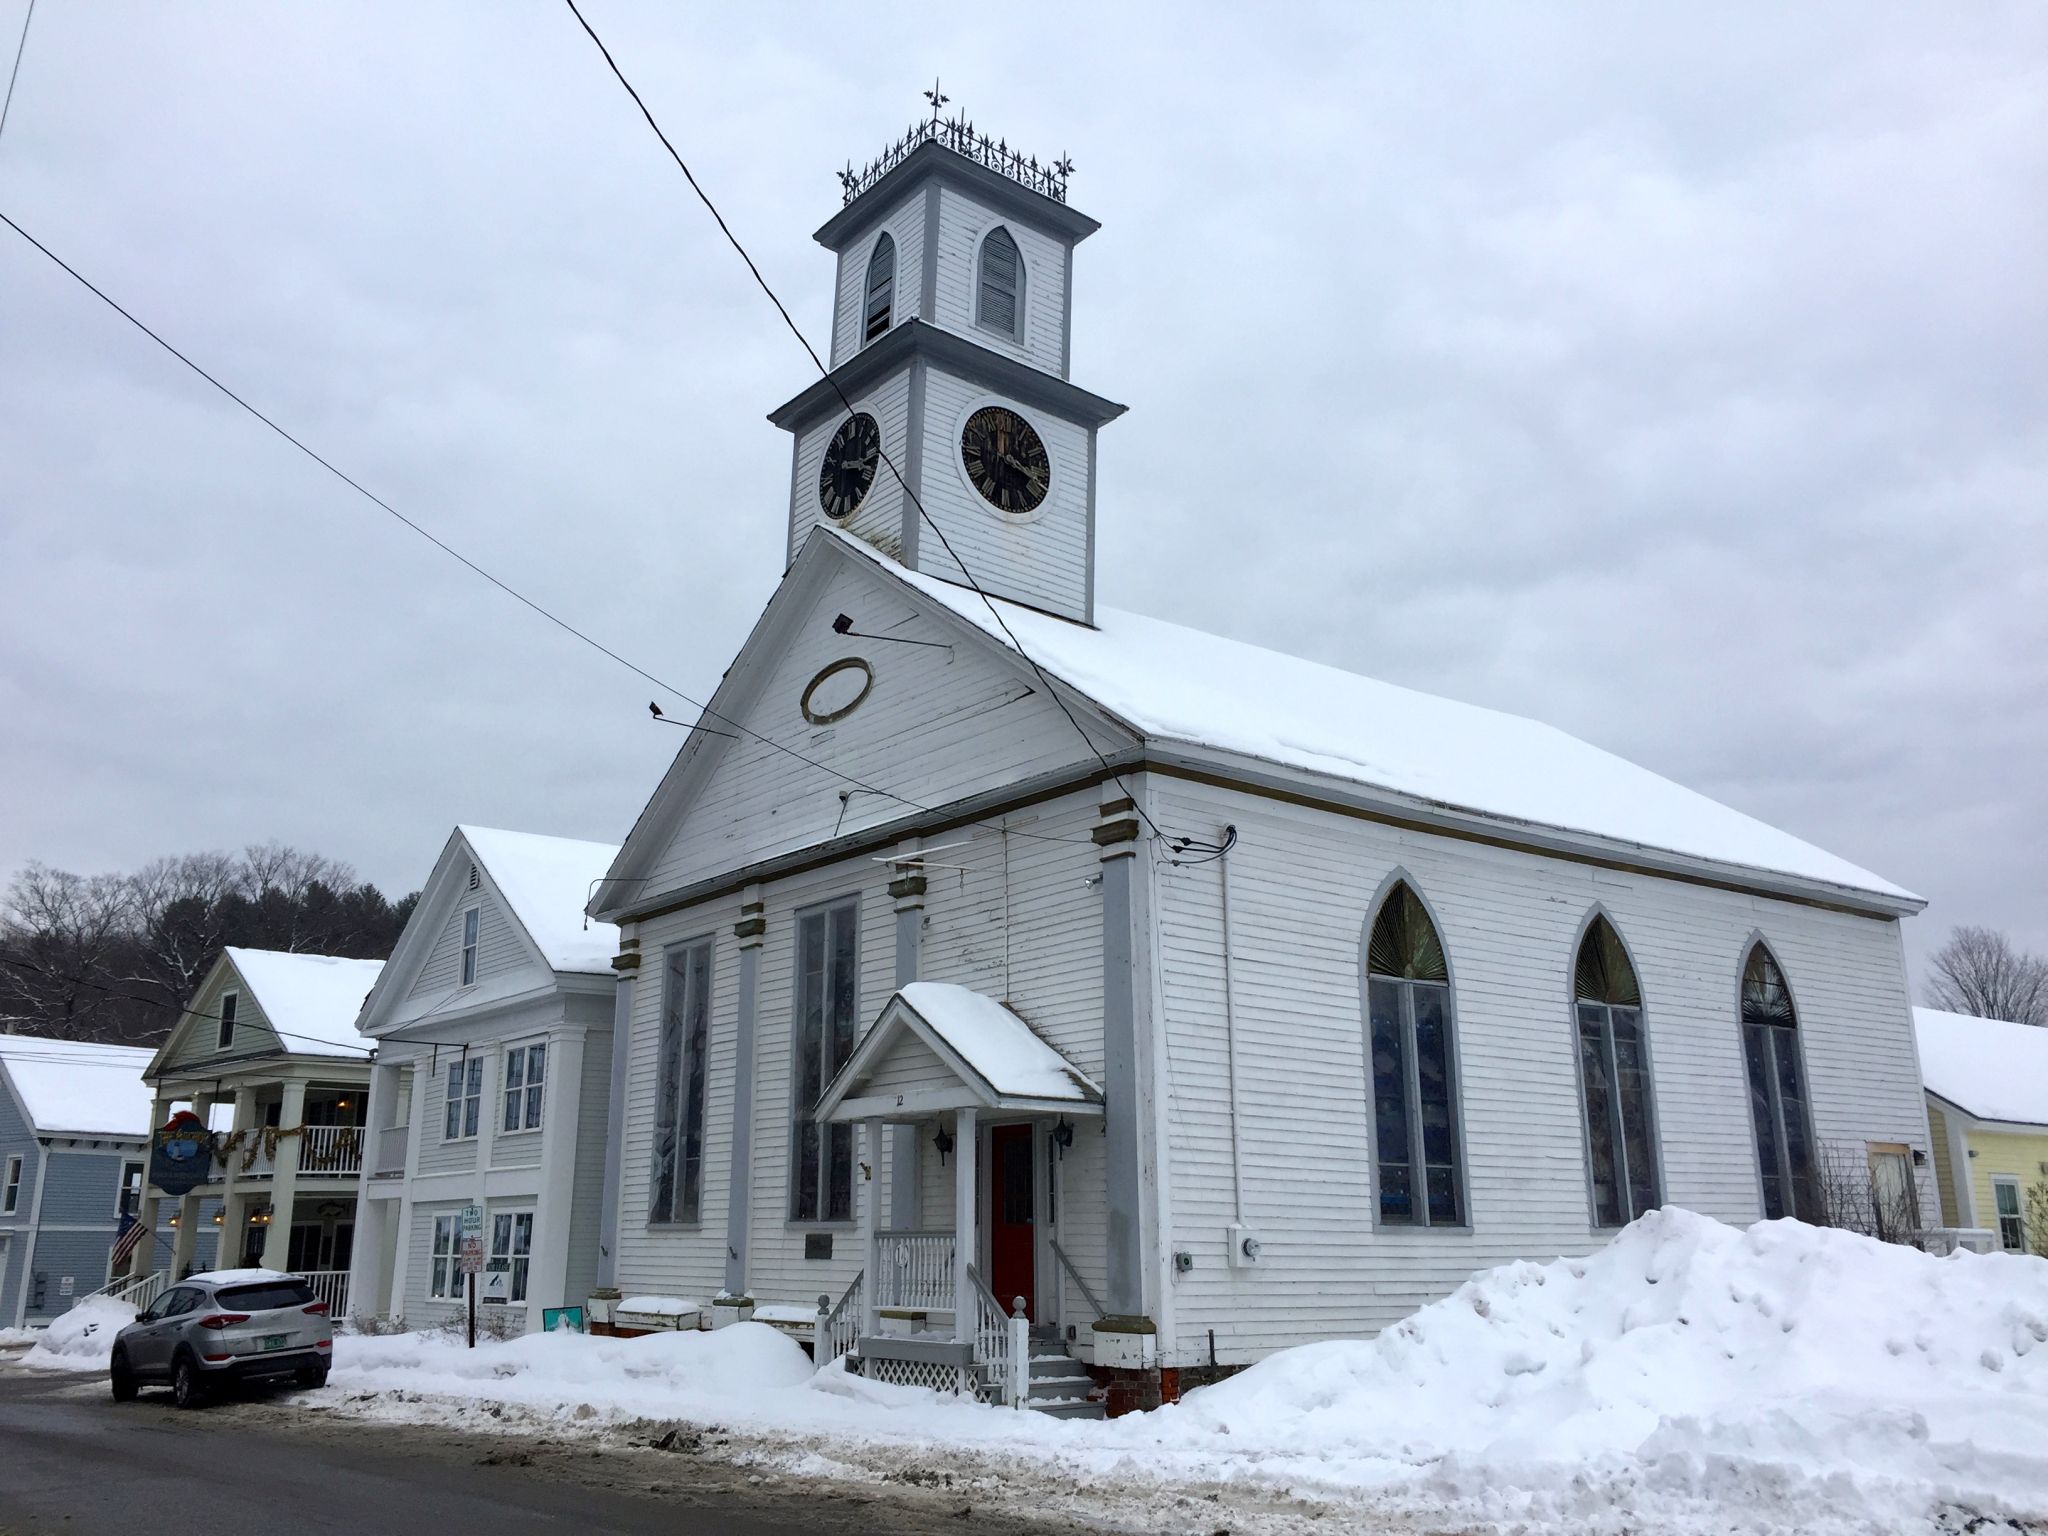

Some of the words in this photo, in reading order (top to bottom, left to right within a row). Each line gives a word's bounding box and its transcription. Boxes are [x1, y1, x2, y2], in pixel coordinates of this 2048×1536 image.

[896, 1094, 904, 1107] 12
[465, 1209, 478, 1217] TWO
[464, 1216, 481, 1224] HOUR
[463, 1223, 482, 1231] PARKING
